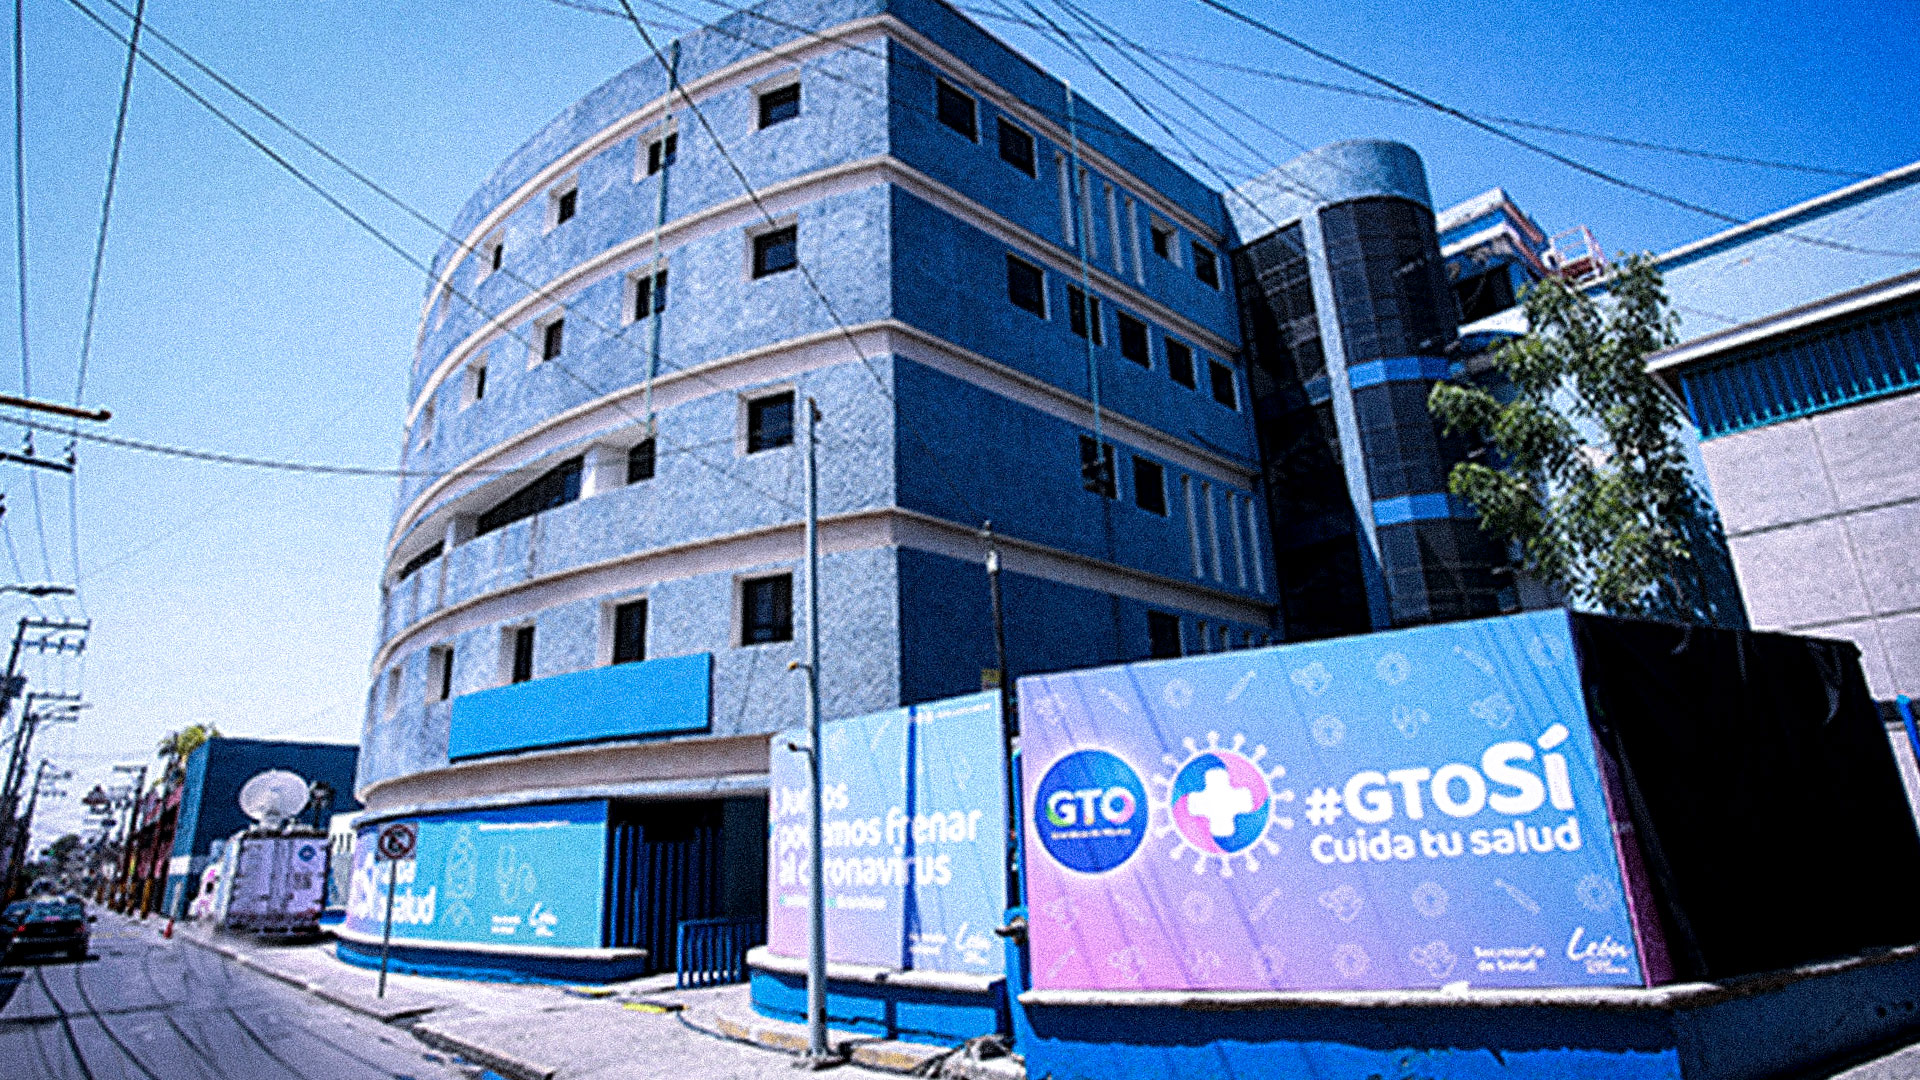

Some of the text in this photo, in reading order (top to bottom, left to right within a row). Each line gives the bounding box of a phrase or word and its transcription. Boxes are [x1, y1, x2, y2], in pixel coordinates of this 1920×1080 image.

[1046, 786, 1137, 828] GTO
[780, 806, 983, 856] pomos frenar
[1309, 817, 1582, 863] Cuida tu salud
[799, 845, 952, 887] cronavirus
